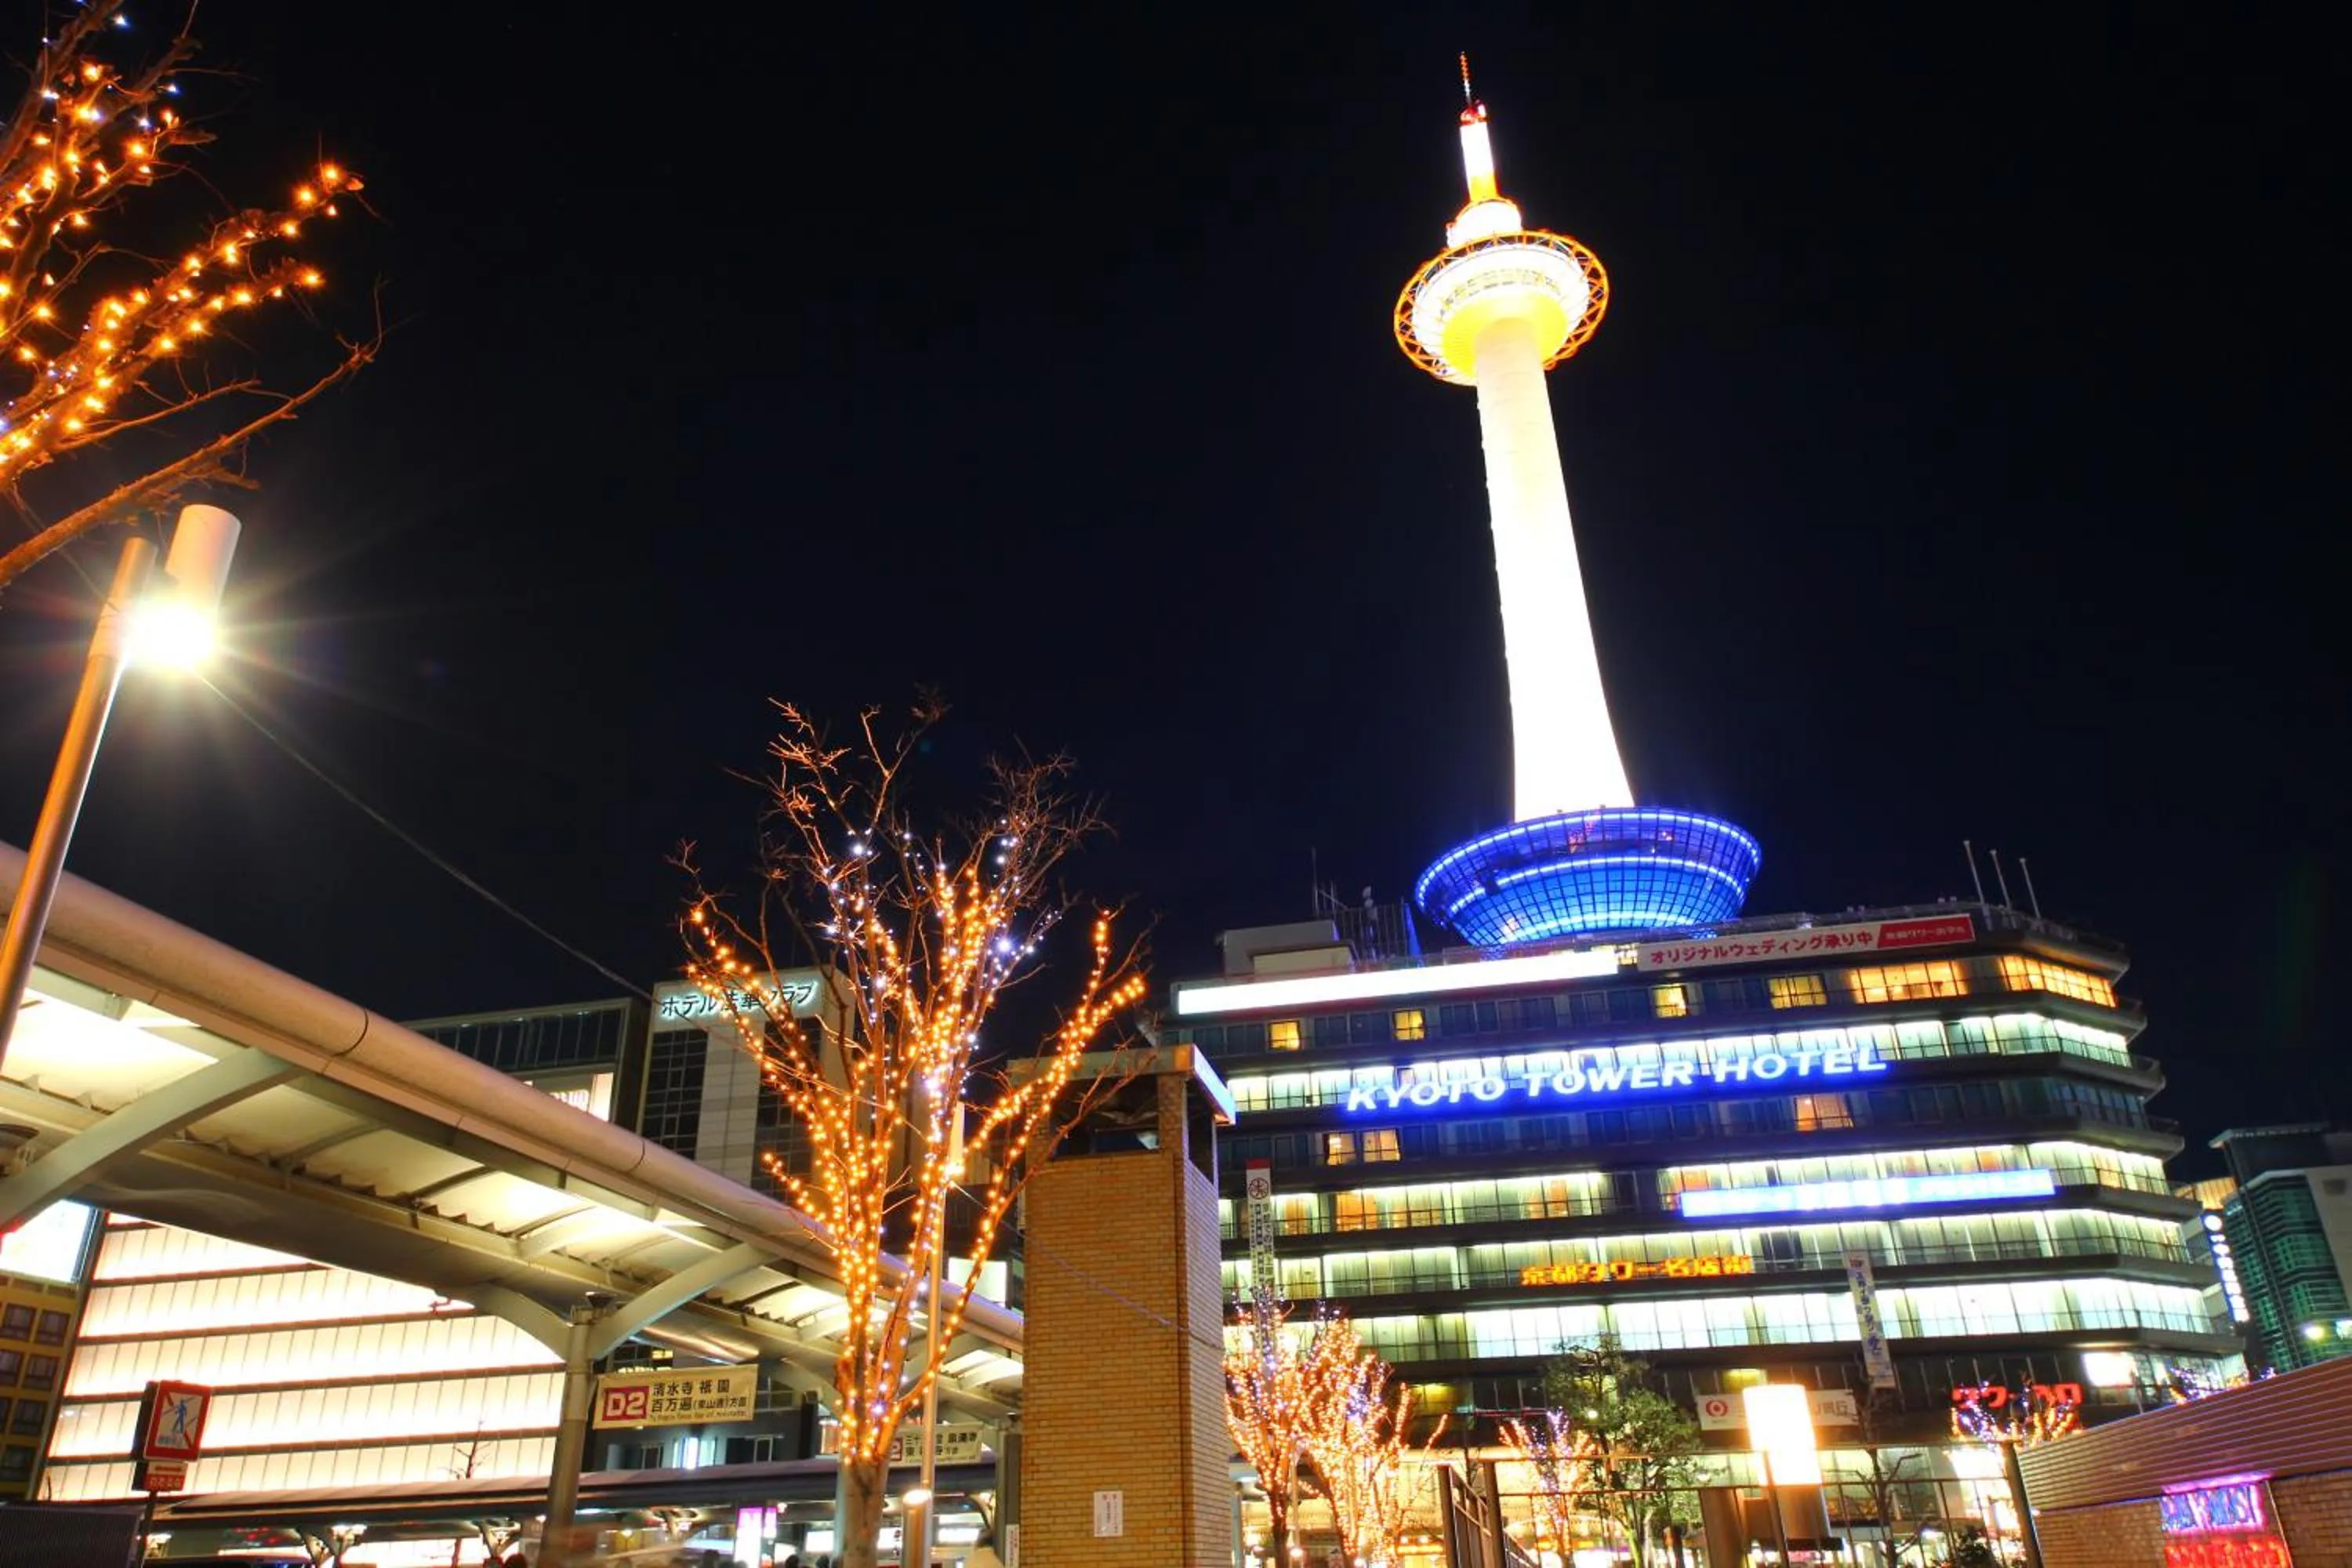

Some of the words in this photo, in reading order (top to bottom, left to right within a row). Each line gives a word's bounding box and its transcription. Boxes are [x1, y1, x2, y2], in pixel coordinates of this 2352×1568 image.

[1346, 1076, 1506, 1112] KYOTO
[1523, 1059, 1693, 1096] TOWER
[1711, 1045, 1889, 1085] HOTEL
[653, 1381, 693, 1396] 清水寺
[607, 1391, 646, 1417] D2
